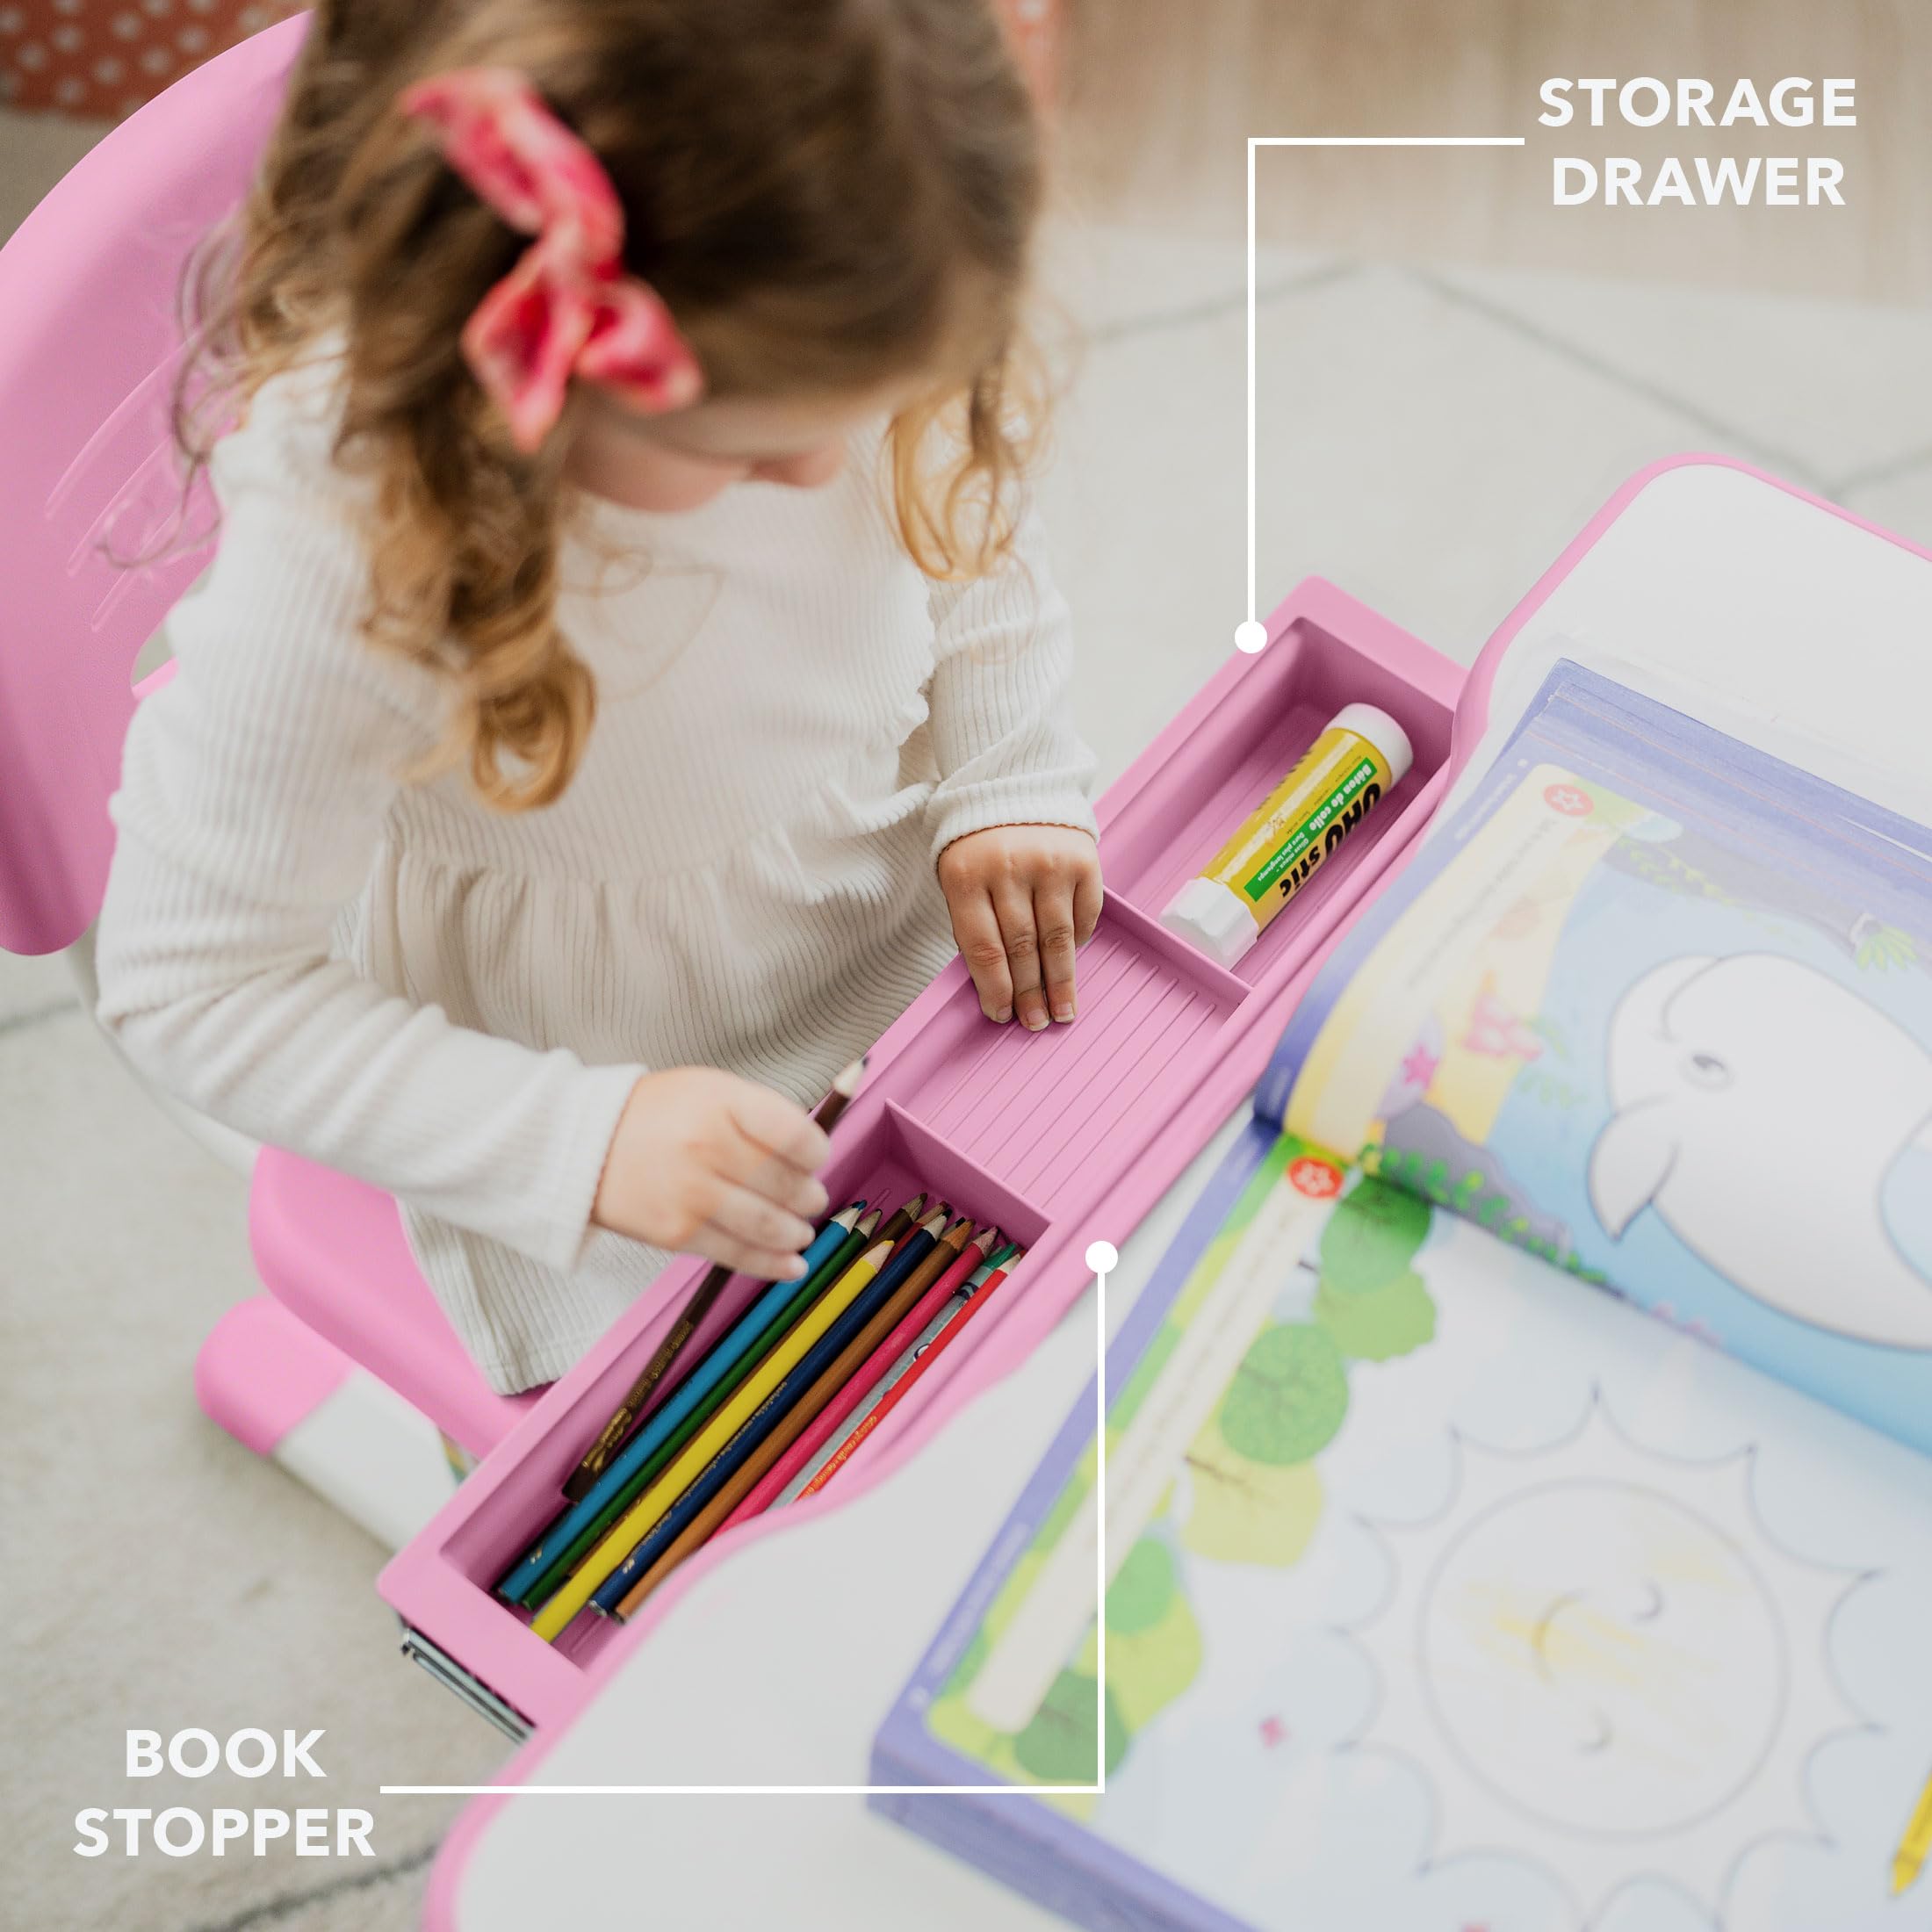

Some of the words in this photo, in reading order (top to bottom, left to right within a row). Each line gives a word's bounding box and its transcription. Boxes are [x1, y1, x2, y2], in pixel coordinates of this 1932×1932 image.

[1308, 806, 1331, 831] colle
[1324, 782, 1381, 858] UHU
[1280, 846, 1321, 898] stic
